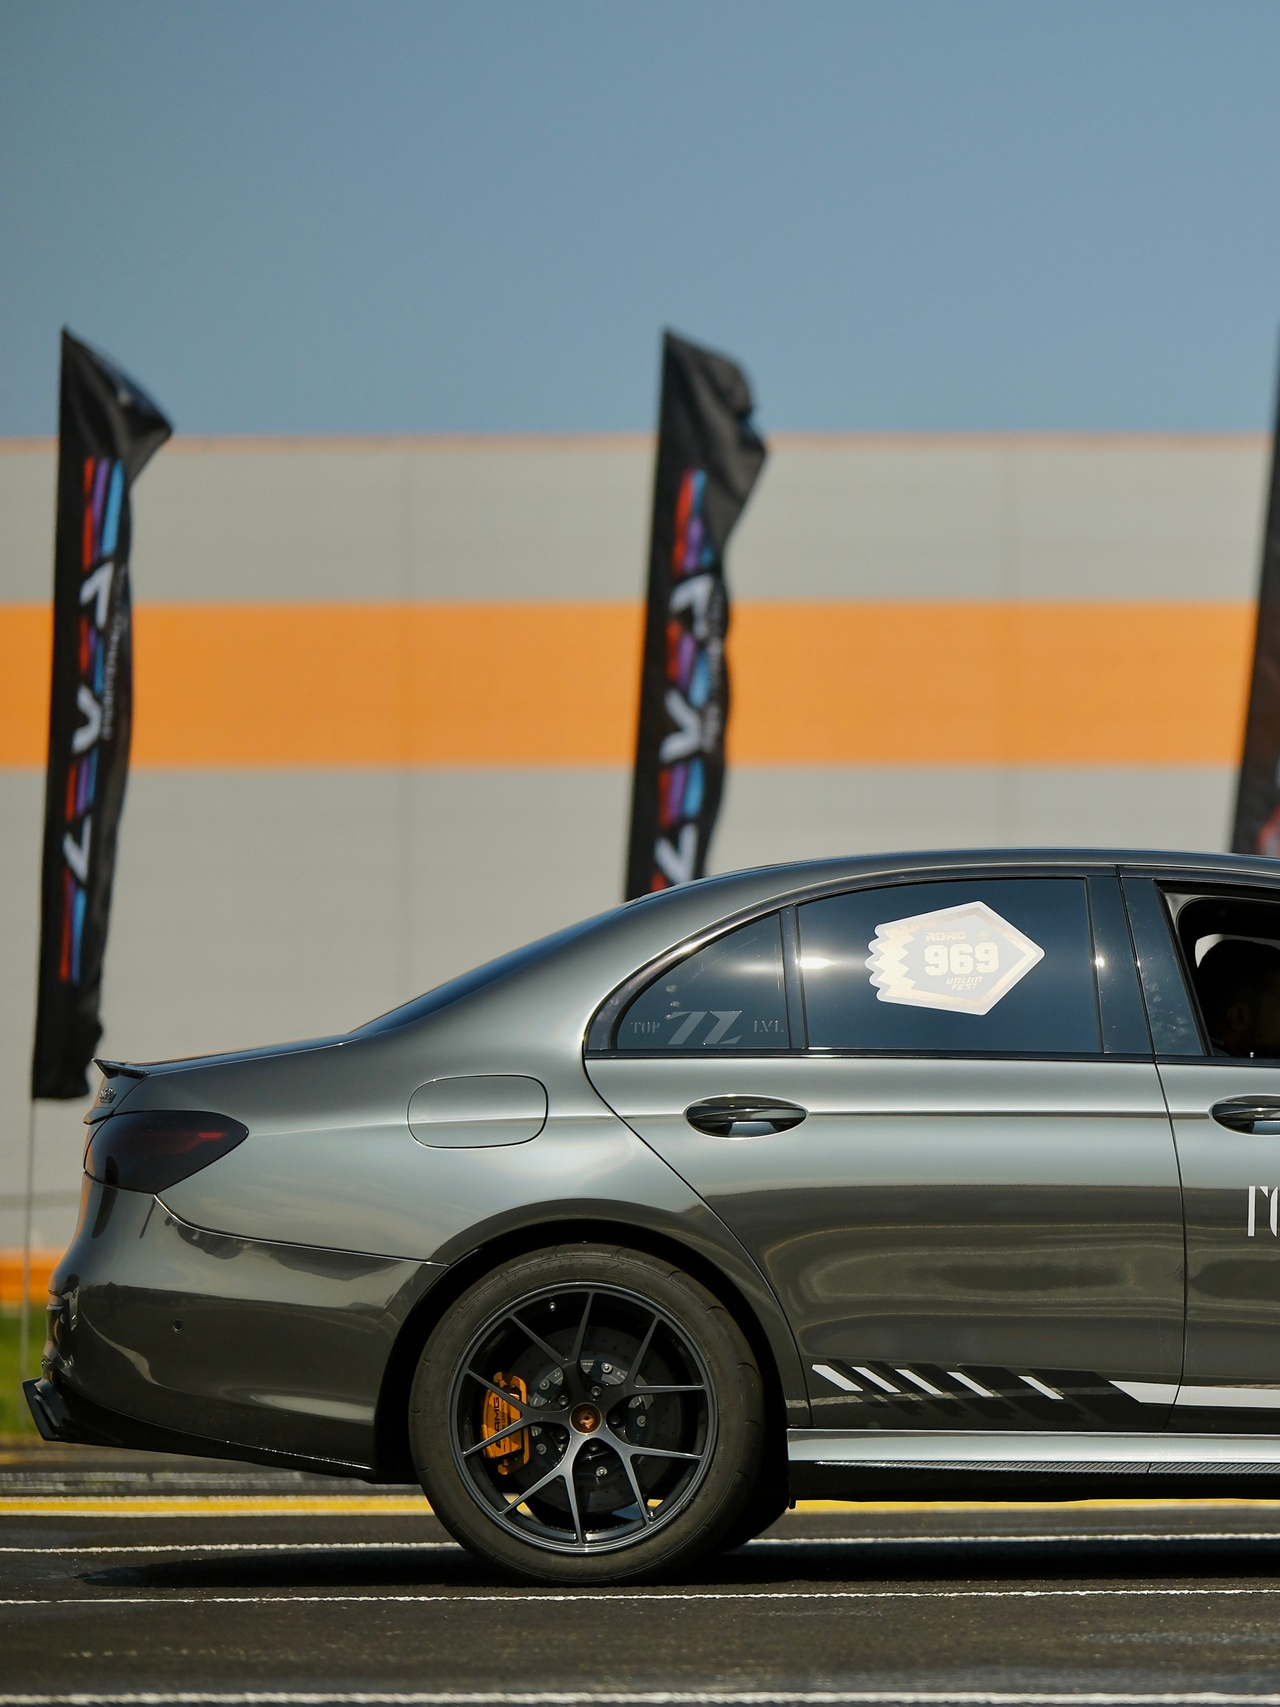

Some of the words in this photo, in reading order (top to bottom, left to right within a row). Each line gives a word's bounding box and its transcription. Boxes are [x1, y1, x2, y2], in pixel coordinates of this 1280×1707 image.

[924, 942, 999, 976] 969
[951, 983, 980, 991] FEST
[630, 1021, 660, 1034] TOP
[493, 1396, 501, 1432] AMG
